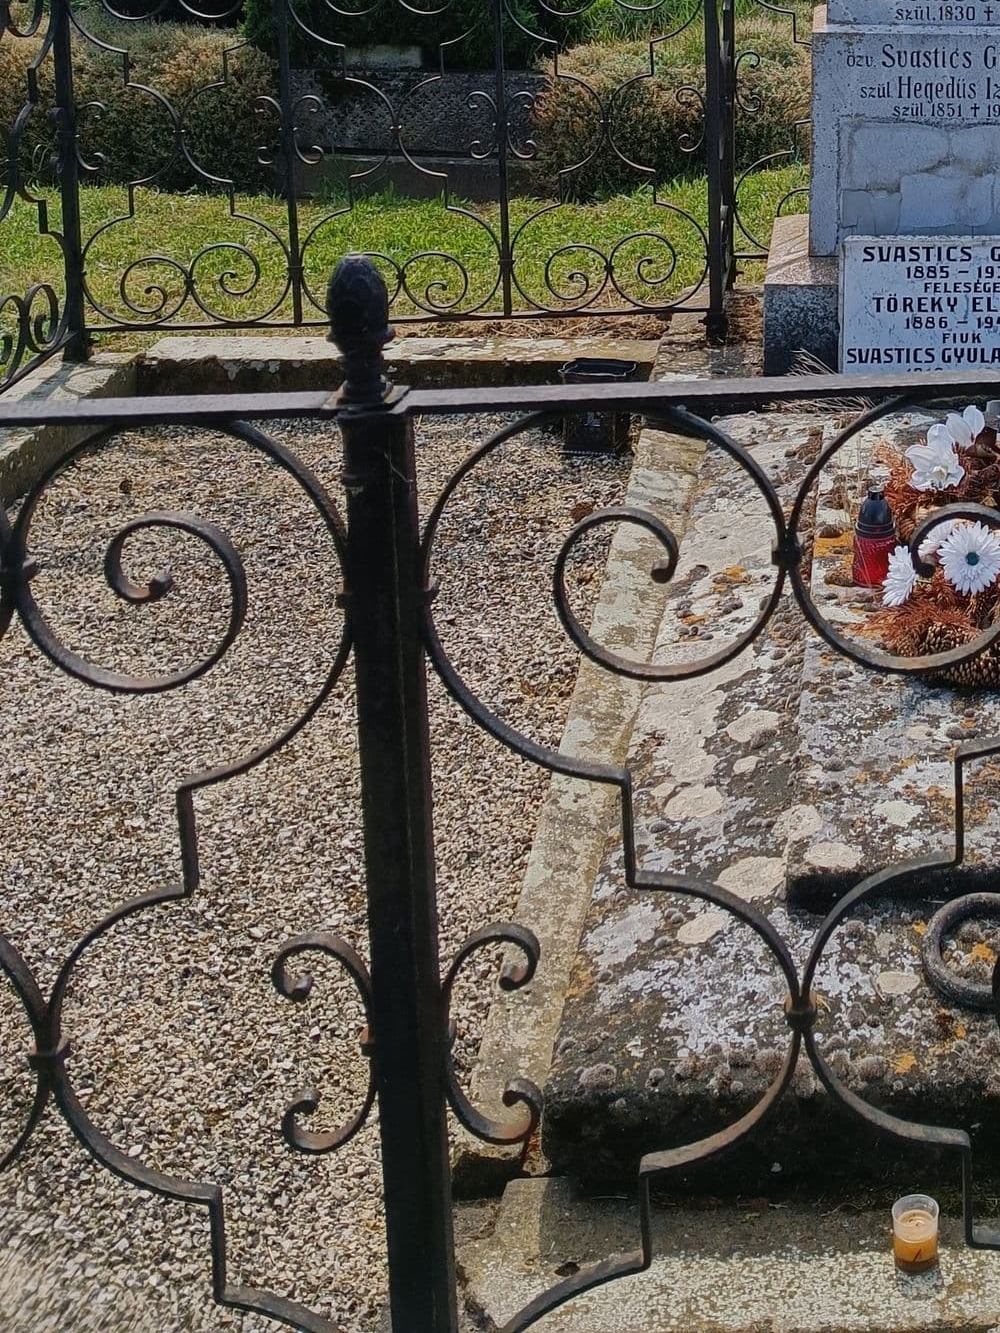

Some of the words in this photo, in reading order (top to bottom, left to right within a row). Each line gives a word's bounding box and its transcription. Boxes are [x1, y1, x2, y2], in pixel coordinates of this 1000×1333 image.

[882, 44, 973, 69] Svastics
[862, 246, 972, 262] SVASTICS
[906, 266, 950, 279] 1885
[873, 293, 958, 313] TÖREKY
[904, 317, 948, 330] 1886
[942, 332, 982, 344] FIUK
[847, 347, 935, 364] SVASTICS
